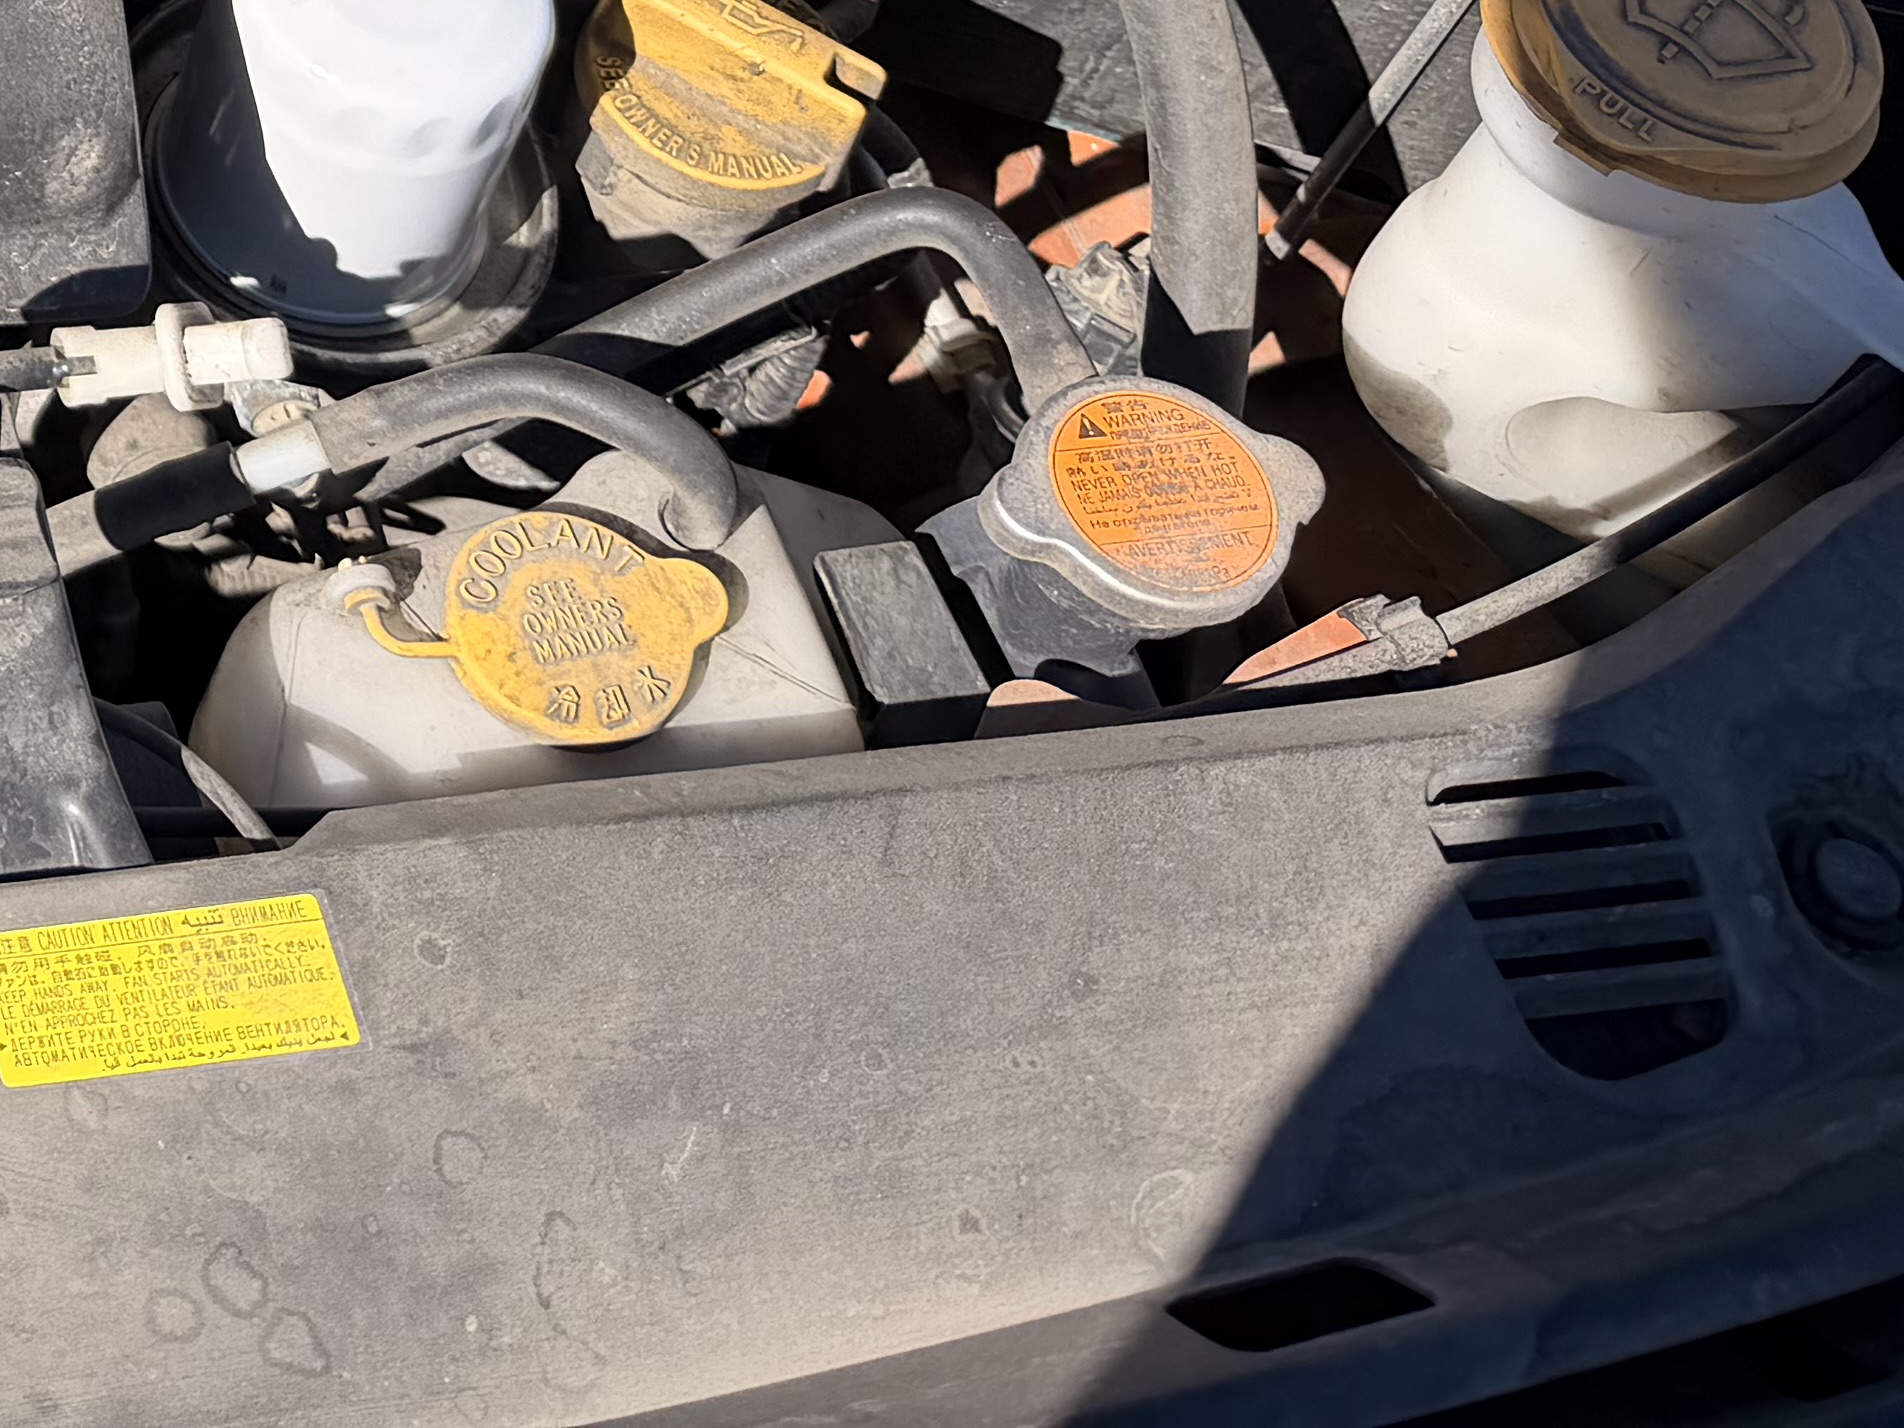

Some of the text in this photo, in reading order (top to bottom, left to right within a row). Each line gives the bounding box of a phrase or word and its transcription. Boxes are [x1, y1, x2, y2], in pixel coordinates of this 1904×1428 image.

[595, 55, 632, 92] SEE
[1574, 76, 1655, 144] PULL
[707, 150, 804, 180] MANUAL
[1102, 407, 1185, 429] WARNING
[1071, 461, 1240, 492] NEVER OPEN WHEN HOT
[1077, 491, 1095, 505] NE
[1098, 488, 1142, 504] JAMAIS
[459, 517, 646, 605] COOLANT
[526, 576, 578, 608] SEE
[523, 596, 625, 636] OWNERS
[532, 622, 636, 664] MANUAL
[0, 900, 308, 955] 注意 CAUTION ATTENTION تنبيه ВНИМАНИЕ
[0, 1004, 16, 1020] LE
[22, 997, 89, 1017] DÉMARRAGE
[95, 994, 111, 1009] DU
[116, 984, 198, 1007] VENTILATEUR
[203, 977, 239, 996] ÉTANT
[34, 983, 73, 1000] HANDS
[123, 973, 149, 989] FAN
[154, 967, 201, 986] STARTS
[3, 995, 235, 1036] N'EN APPROCHEZ PAS LES MAINS.
[10, 1032, 77, 1053] ДЕРЖИТЕ
[78, 1027, 119, 1045] РУКИ
[134, 1016, 207, 1036] СТОРОНЕ.
[13, 1038, 146, 1068] АВТОМАТИЧЕСКОЕ
[148, 1027, 233, 1051] ВКЛЮЧЕНИЕ
[236, 1014, 345, 1040] ВЕНТИЛЯТОРА.
